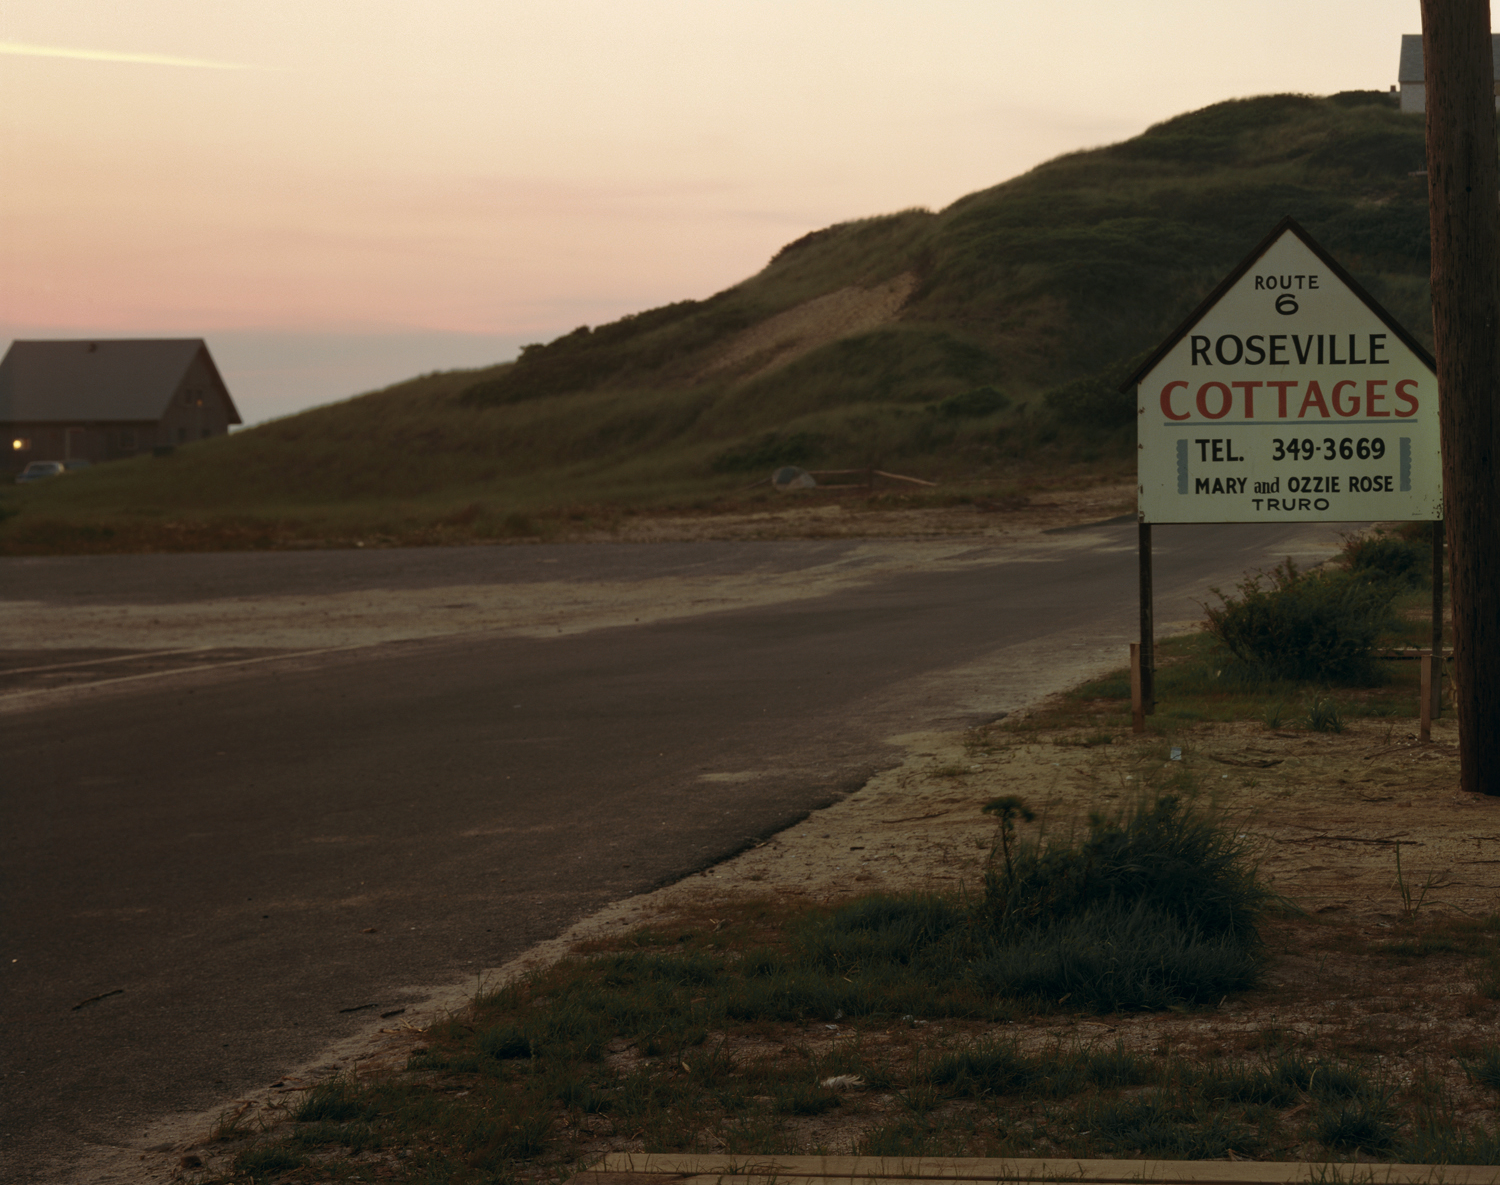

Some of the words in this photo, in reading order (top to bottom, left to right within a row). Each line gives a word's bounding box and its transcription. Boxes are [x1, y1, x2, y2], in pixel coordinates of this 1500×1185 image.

[1254, 275, 1320, 290] ROUTE
[1275, 293, 1299, 316] 6
[1190, 333, 1390, 366] ROSEVILLE
[1159, 379, 1420, 421] COTTAGES
[1195, 438, 1245, 462] TEL.
[1272, 437, 1386, 461] 349-3669
[1195, 477, 1248, 495] MARY
[1253, 476, 1280, 494] and
[1287, 476, 1341, 493] OZZIE
[1348, 475, 1394, 493] ROSE
[1251, 498, 1330, 511] TRURO
